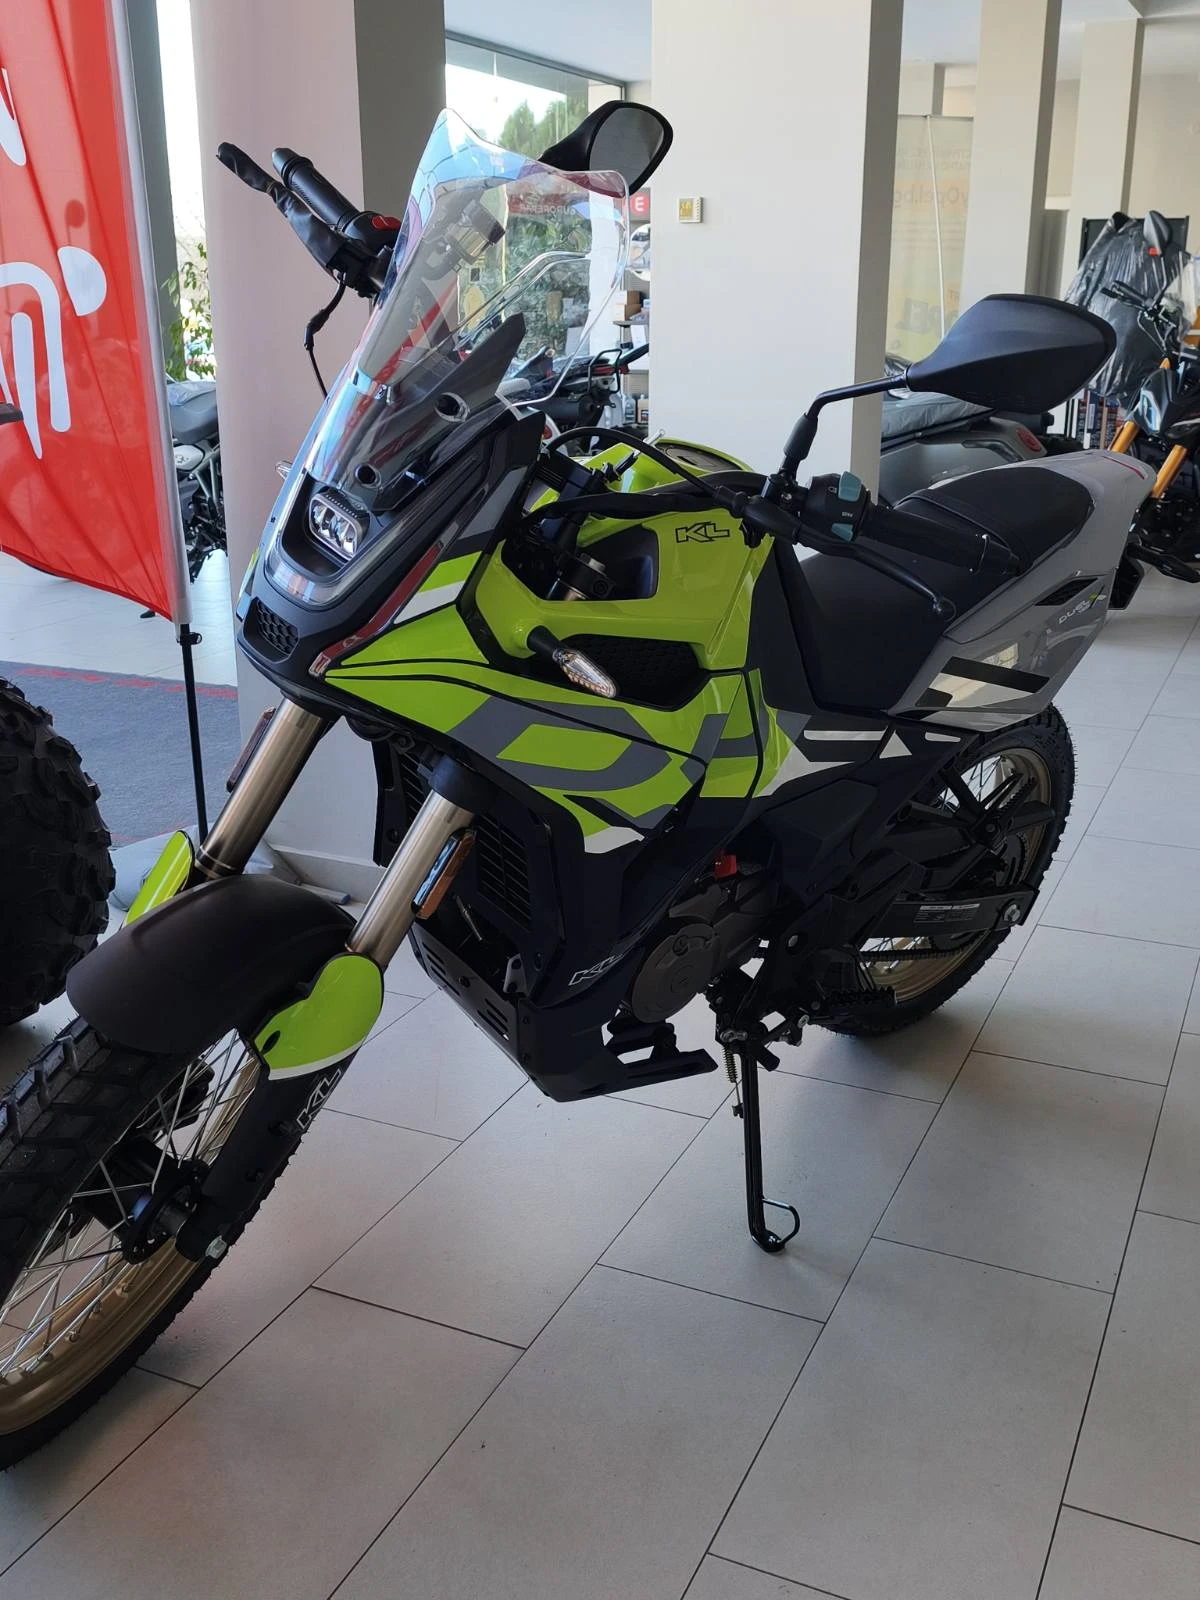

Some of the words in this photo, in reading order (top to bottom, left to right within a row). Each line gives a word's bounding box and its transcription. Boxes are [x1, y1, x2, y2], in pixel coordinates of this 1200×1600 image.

[675, 521, 730, 543] KL
[568, 953, 625, 986] KL
[297, 1068, 341, 1129] KL
